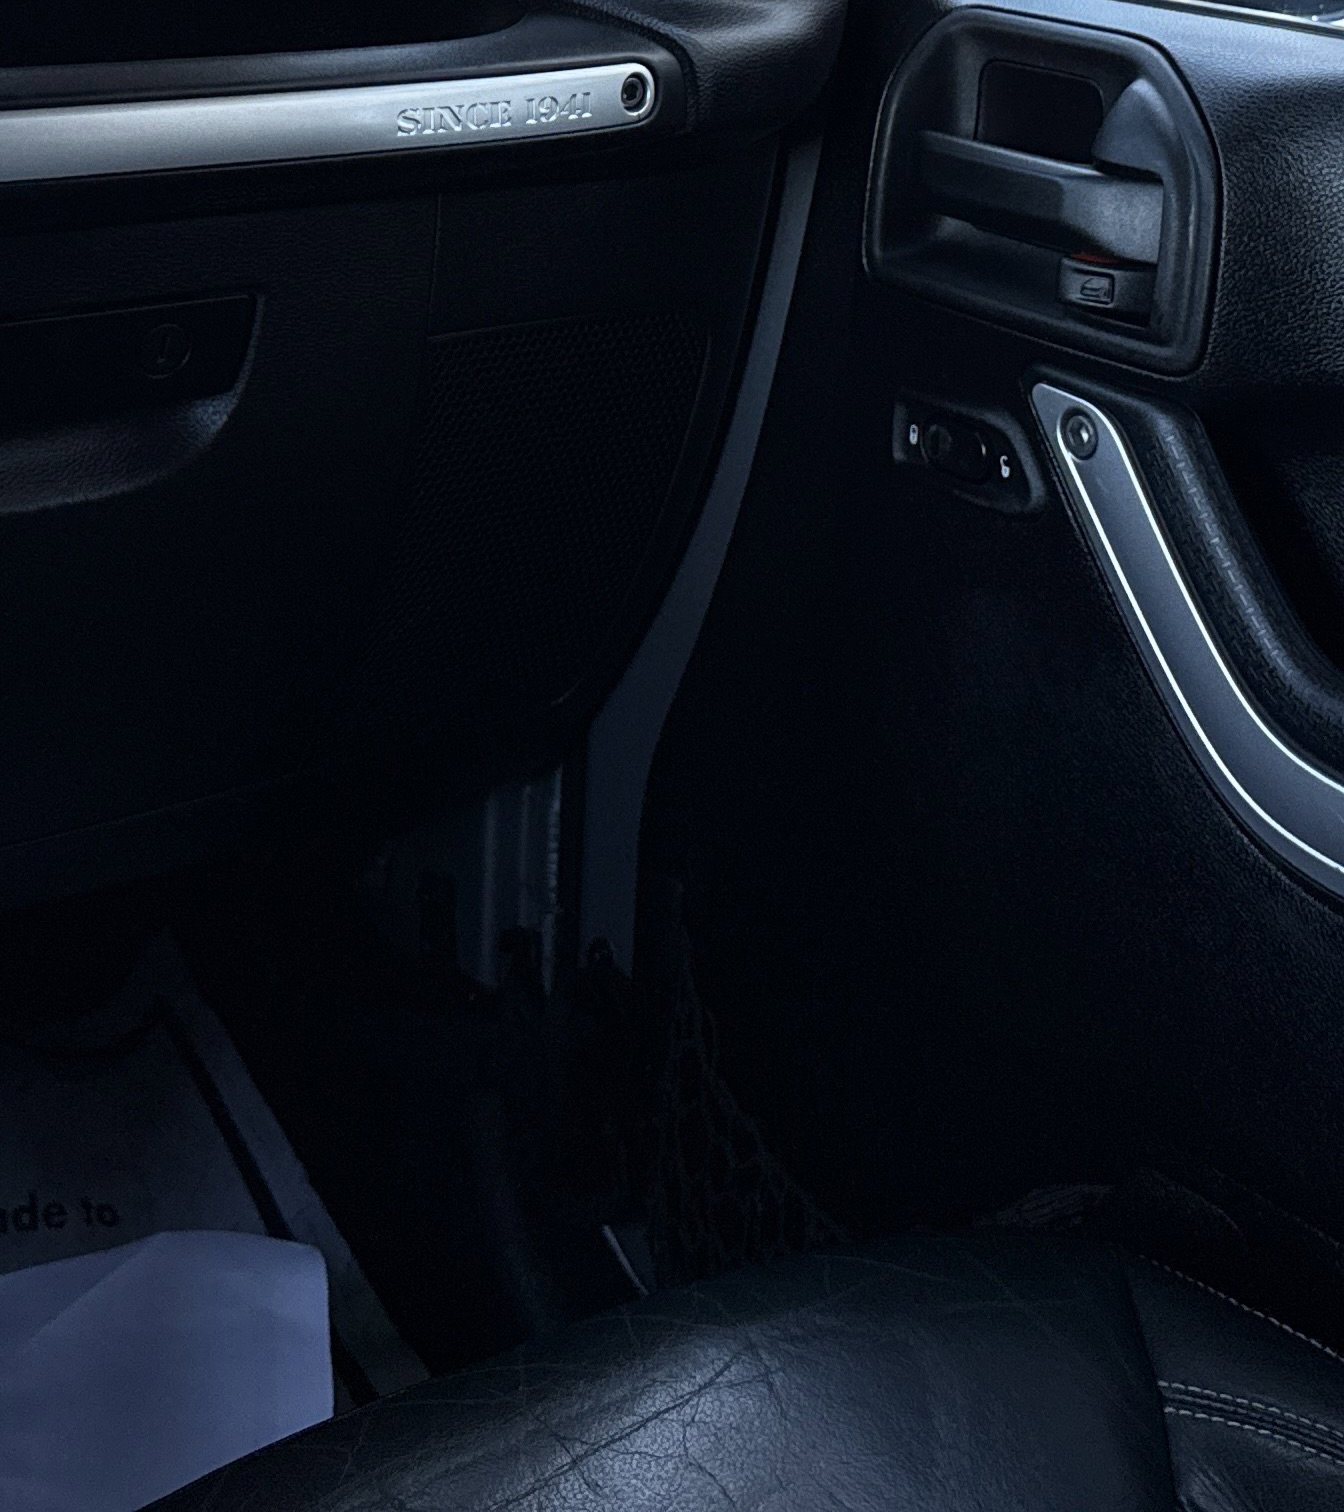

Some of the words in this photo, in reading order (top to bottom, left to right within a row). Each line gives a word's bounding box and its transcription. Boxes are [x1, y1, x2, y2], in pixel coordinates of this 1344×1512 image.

[396, 99, 512, 136] SINCE
[525, 91, 592, 125] 1941
[79, 1197, 118, 1227] to
